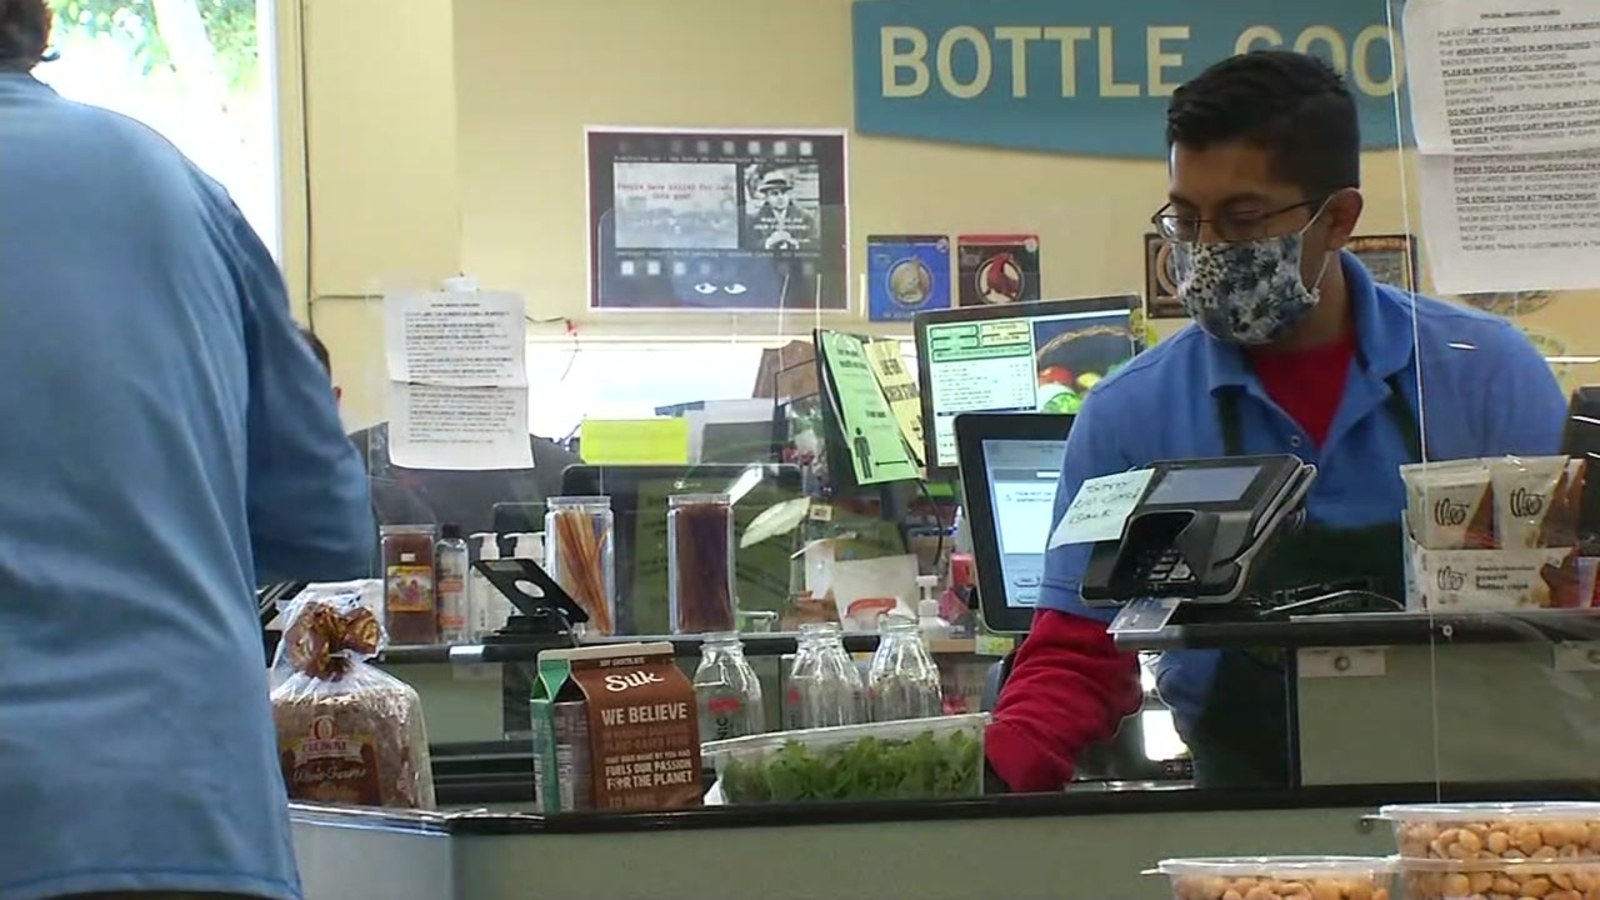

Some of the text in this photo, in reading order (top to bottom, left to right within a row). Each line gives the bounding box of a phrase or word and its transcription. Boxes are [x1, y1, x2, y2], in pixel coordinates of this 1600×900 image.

[880, 25, 1190, 98] BOTTLE
[604, 671, 665, 692] Silk
[601, 702, 688, 726] WE BELIEVE
[605, 759, 693, 777] FUELS OUR PASSION
[606, 771, 693, 790] FOR THE PLANET
